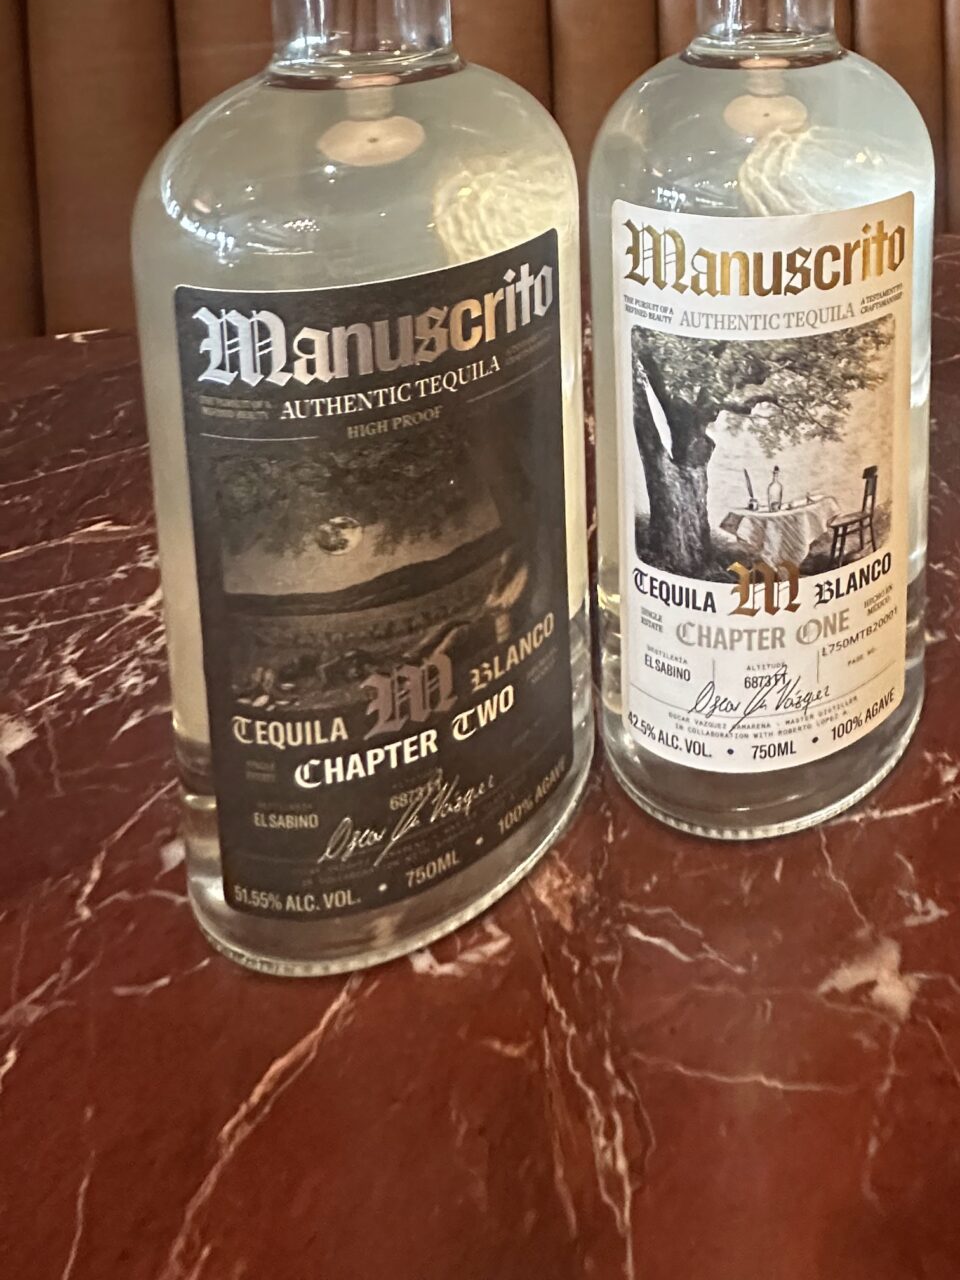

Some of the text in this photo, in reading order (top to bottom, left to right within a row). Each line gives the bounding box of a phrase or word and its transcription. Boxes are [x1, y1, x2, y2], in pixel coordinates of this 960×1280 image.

[622, 218, 906, 298] Manuscrito
[192, 263, 553, 387] Manuscrito
[679, 302, 856, 330] AUTHENTIC TEQUILA
[280, 355, 501, 420] AUTHENTIC TEQUILA
[346, 405, 444, 440] HIGH PROOF
[632, 567, 717, 613] TEQUILA
[814, 552, 892, 608] BLANCO
[676, 607, 850, 651] CHAPTER ONE
[231, 715, 349, 751] TEQUILA
[469, 612, 555, 695] BLANCO
[294, 684, 514, 789] CHAPTER TWO
[627, 686, 896, 760] 42.5% ALC. VOL. 750ML 100% AGAVE
[233, 884, 283, 911] 51.55%
[285, 894, 321, 912] ALC.
[322, 888, 362, 910] VOL.
[404, 849, 461, 888] 750ML
[498, 796, 534, 835] 100%
